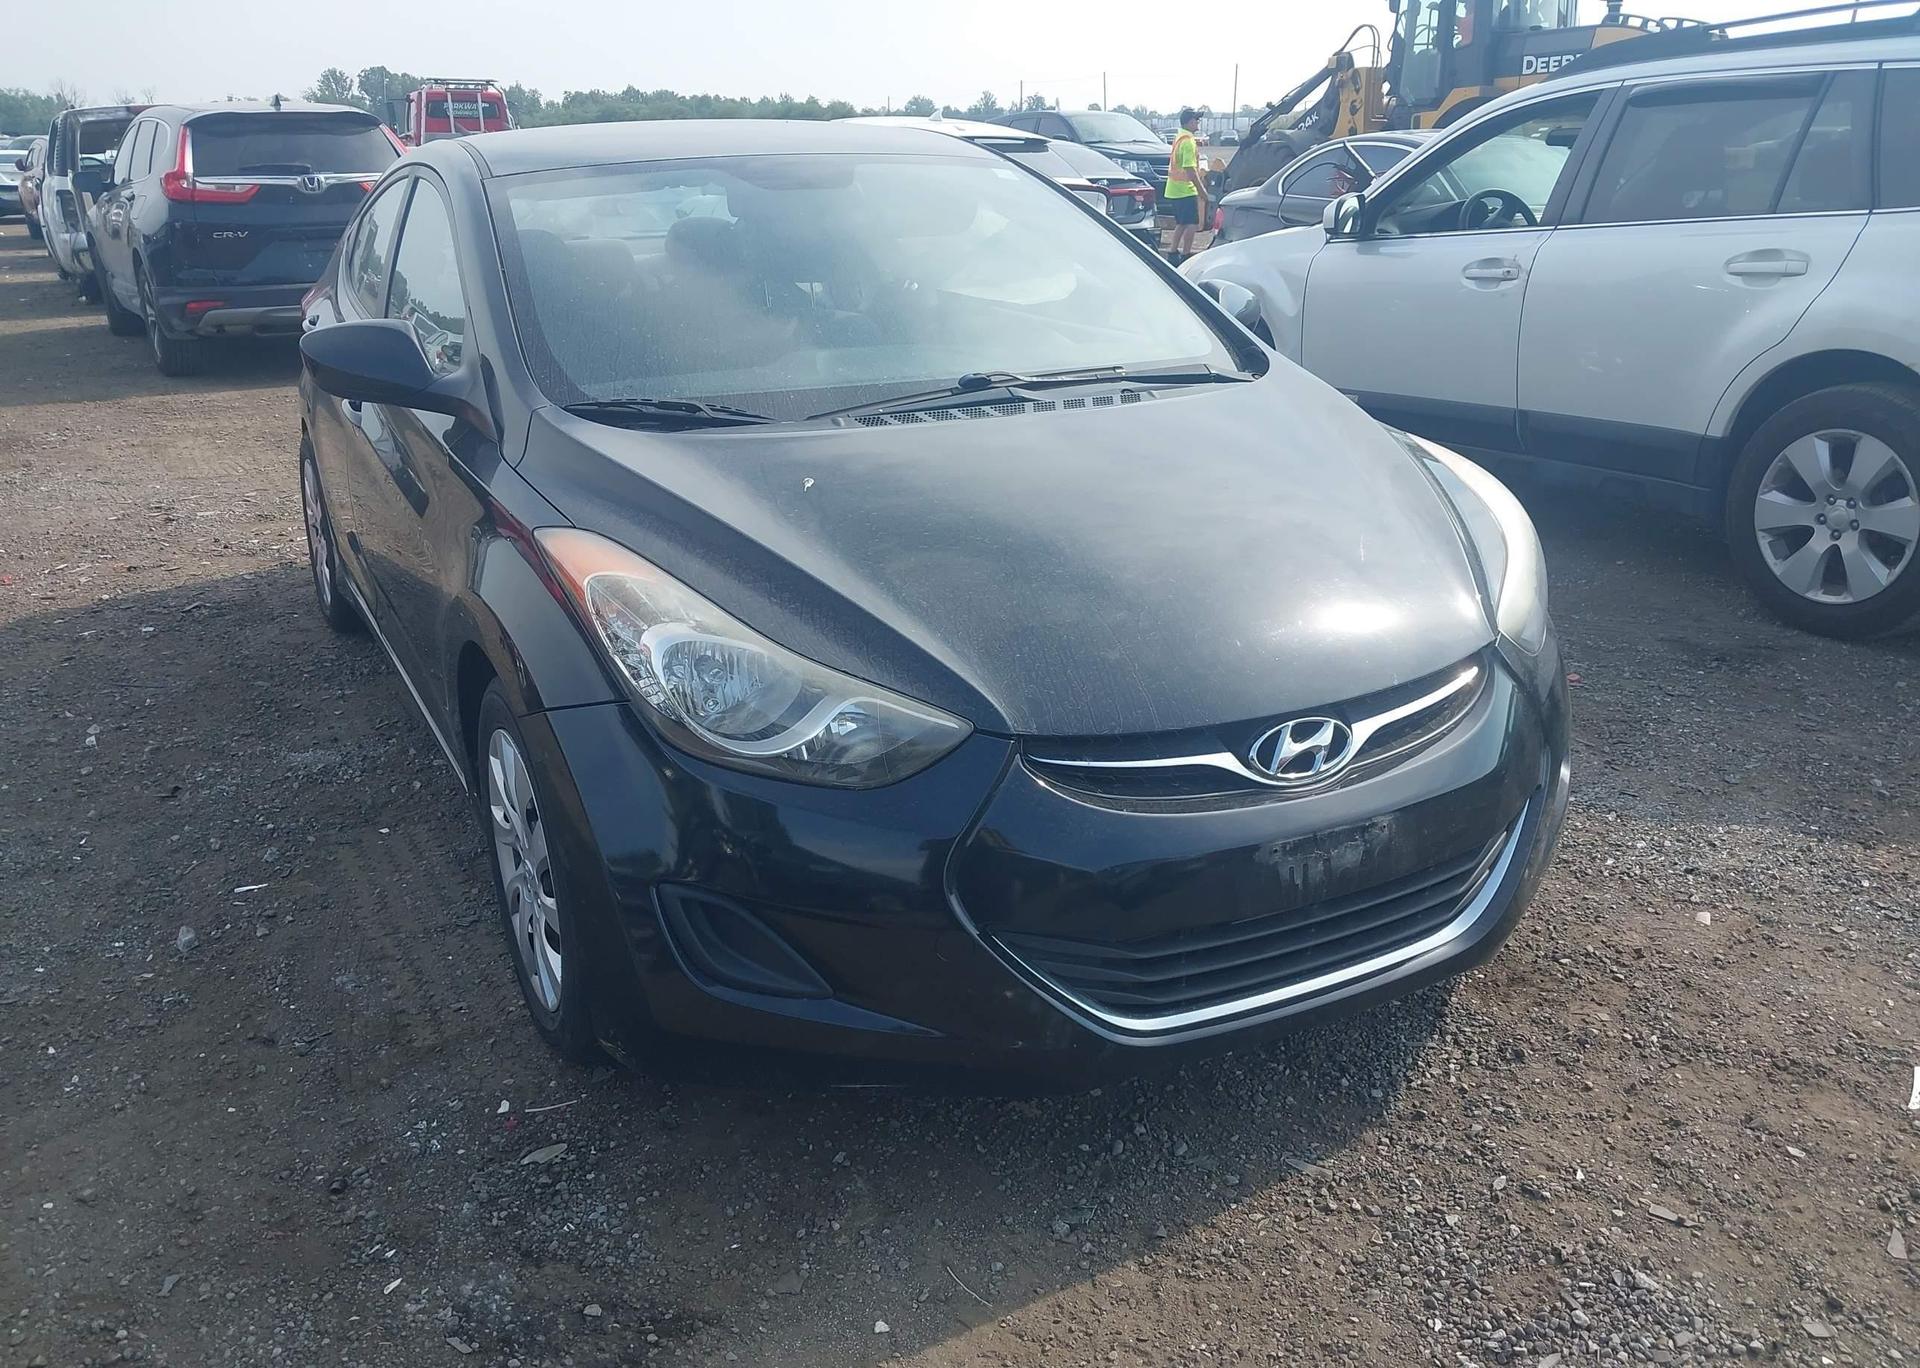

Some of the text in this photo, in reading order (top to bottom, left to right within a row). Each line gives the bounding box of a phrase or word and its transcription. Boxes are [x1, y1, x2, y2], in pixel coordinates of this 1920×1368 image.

[1522, 53, 1583, 75] DEER
[1296, 111, 1319, 131] 24K
[212, 231, 248, 239] CR-V
